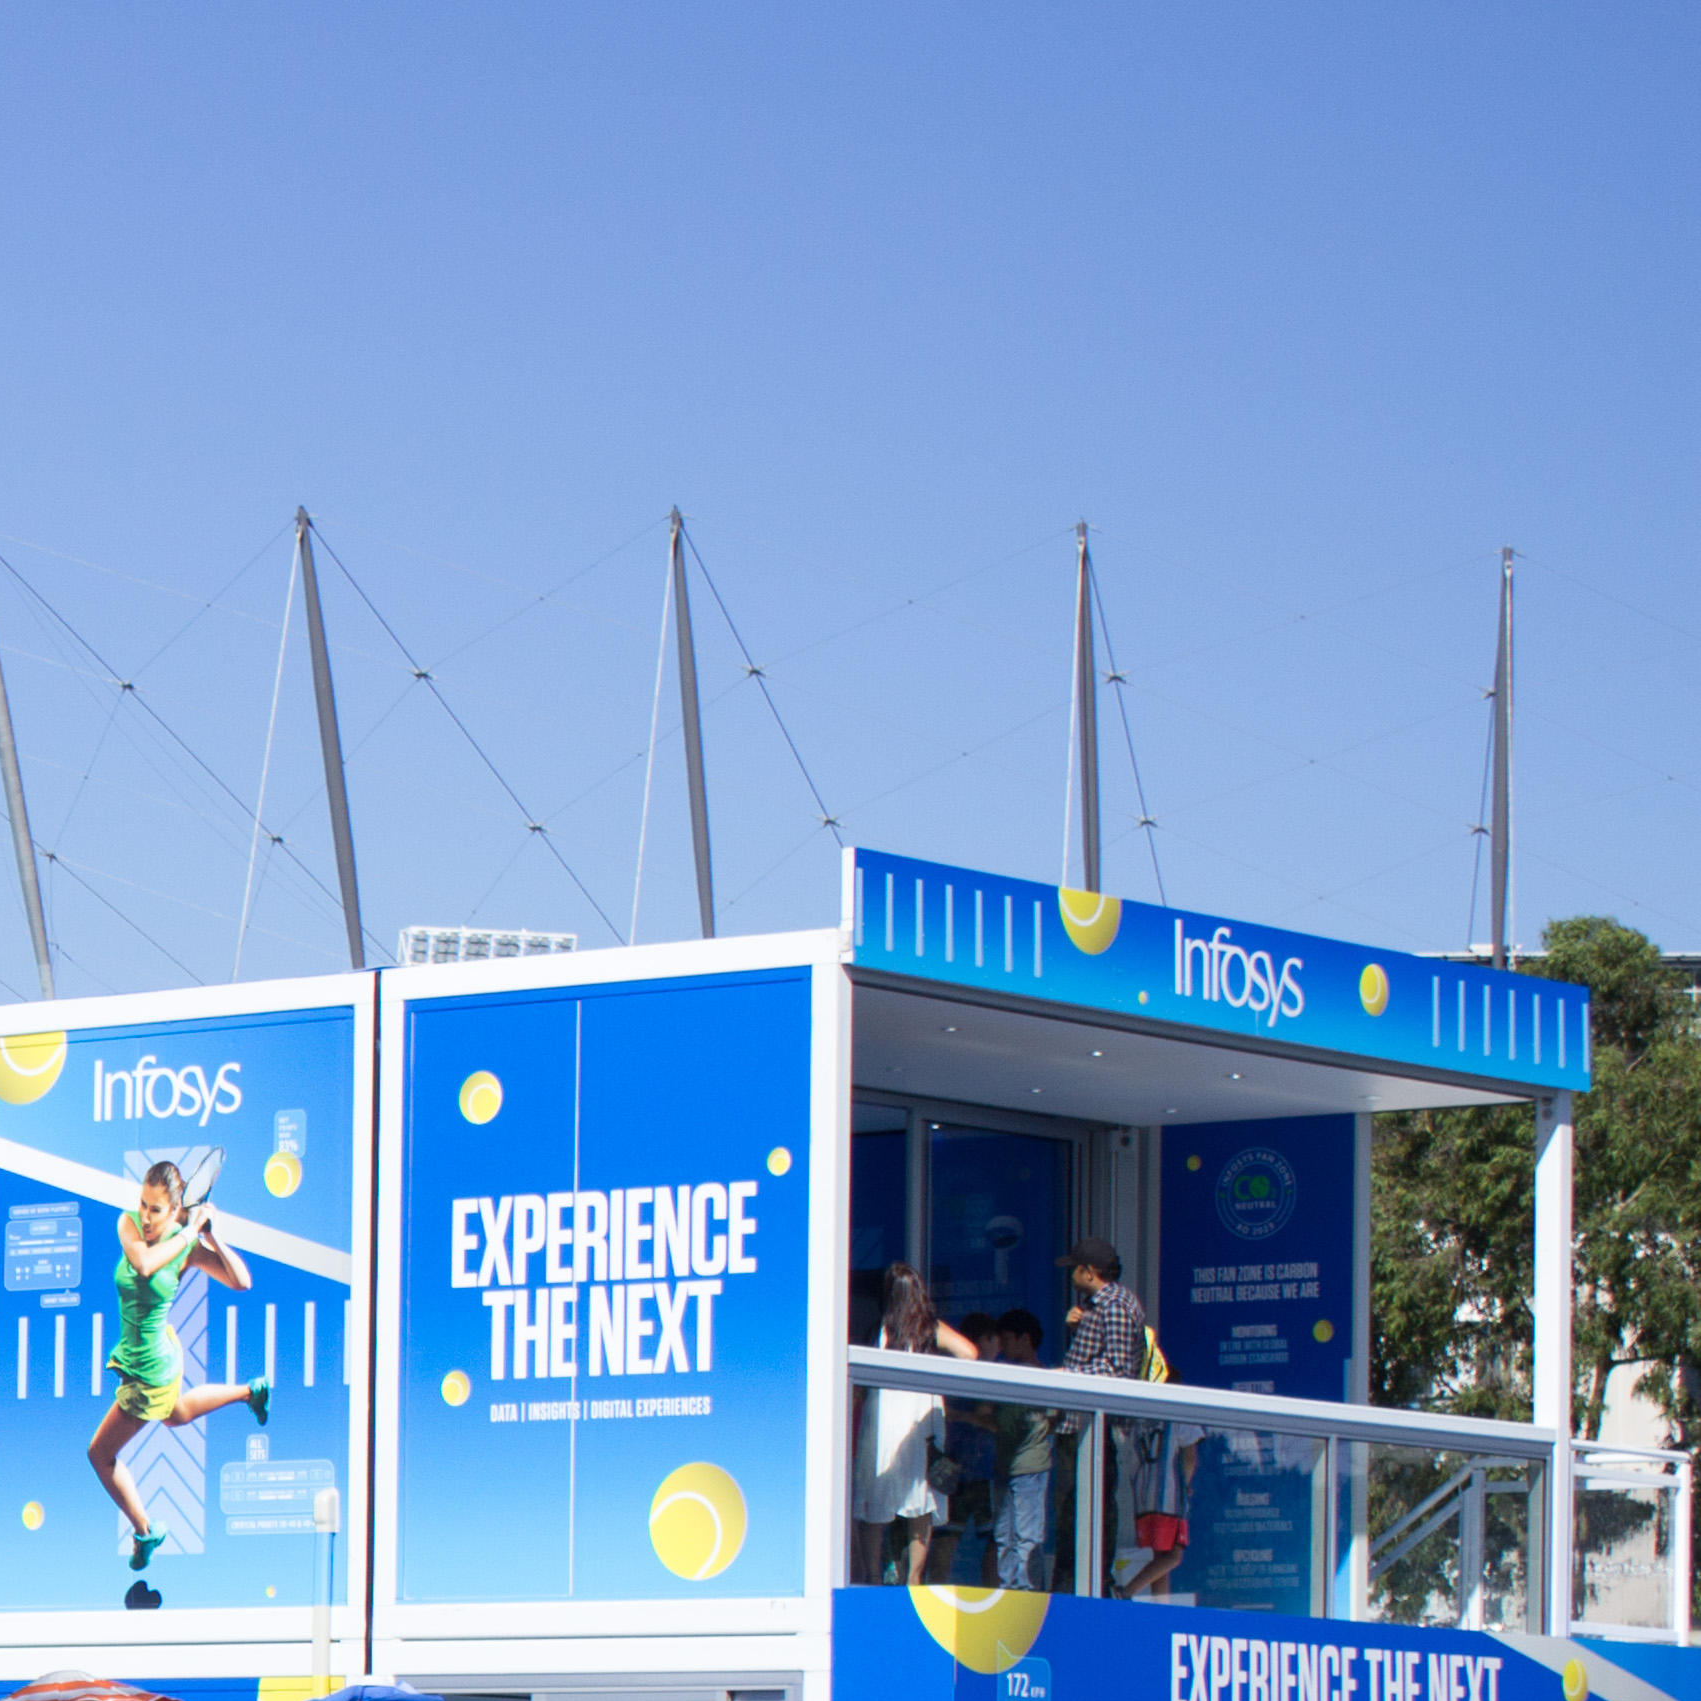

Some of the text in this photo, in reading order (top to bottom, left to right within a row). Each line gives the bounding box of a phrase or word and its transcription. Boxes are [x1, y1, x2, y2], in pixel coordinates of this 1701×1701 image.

[1174, 918, 1305, 1028] Infosys
[94, 1055, 242, 1127] Infosys
[1235, 1201, 1277, 1211] NEUTRAL
[451, 1181, 758, 1288] EXPERIENCE
[1194, 1262, 1319, 1284] THIS FAN ZONE IS CARBON
[1191, 1281, 1320, 1304] NEUTRAL BECAUSE WE ARE
[482, 1280, 722, 1380] THE NEXT
[490, 1404, 518, 1422] DATA
[528, 1402, 581, 1421] INSIGHTS
[590, 1400, 634, 1419] DIGITAL
[635, 1396, 712, 1417] EXPERIENCES
[1006, 1672, 1031, 1698] 172
